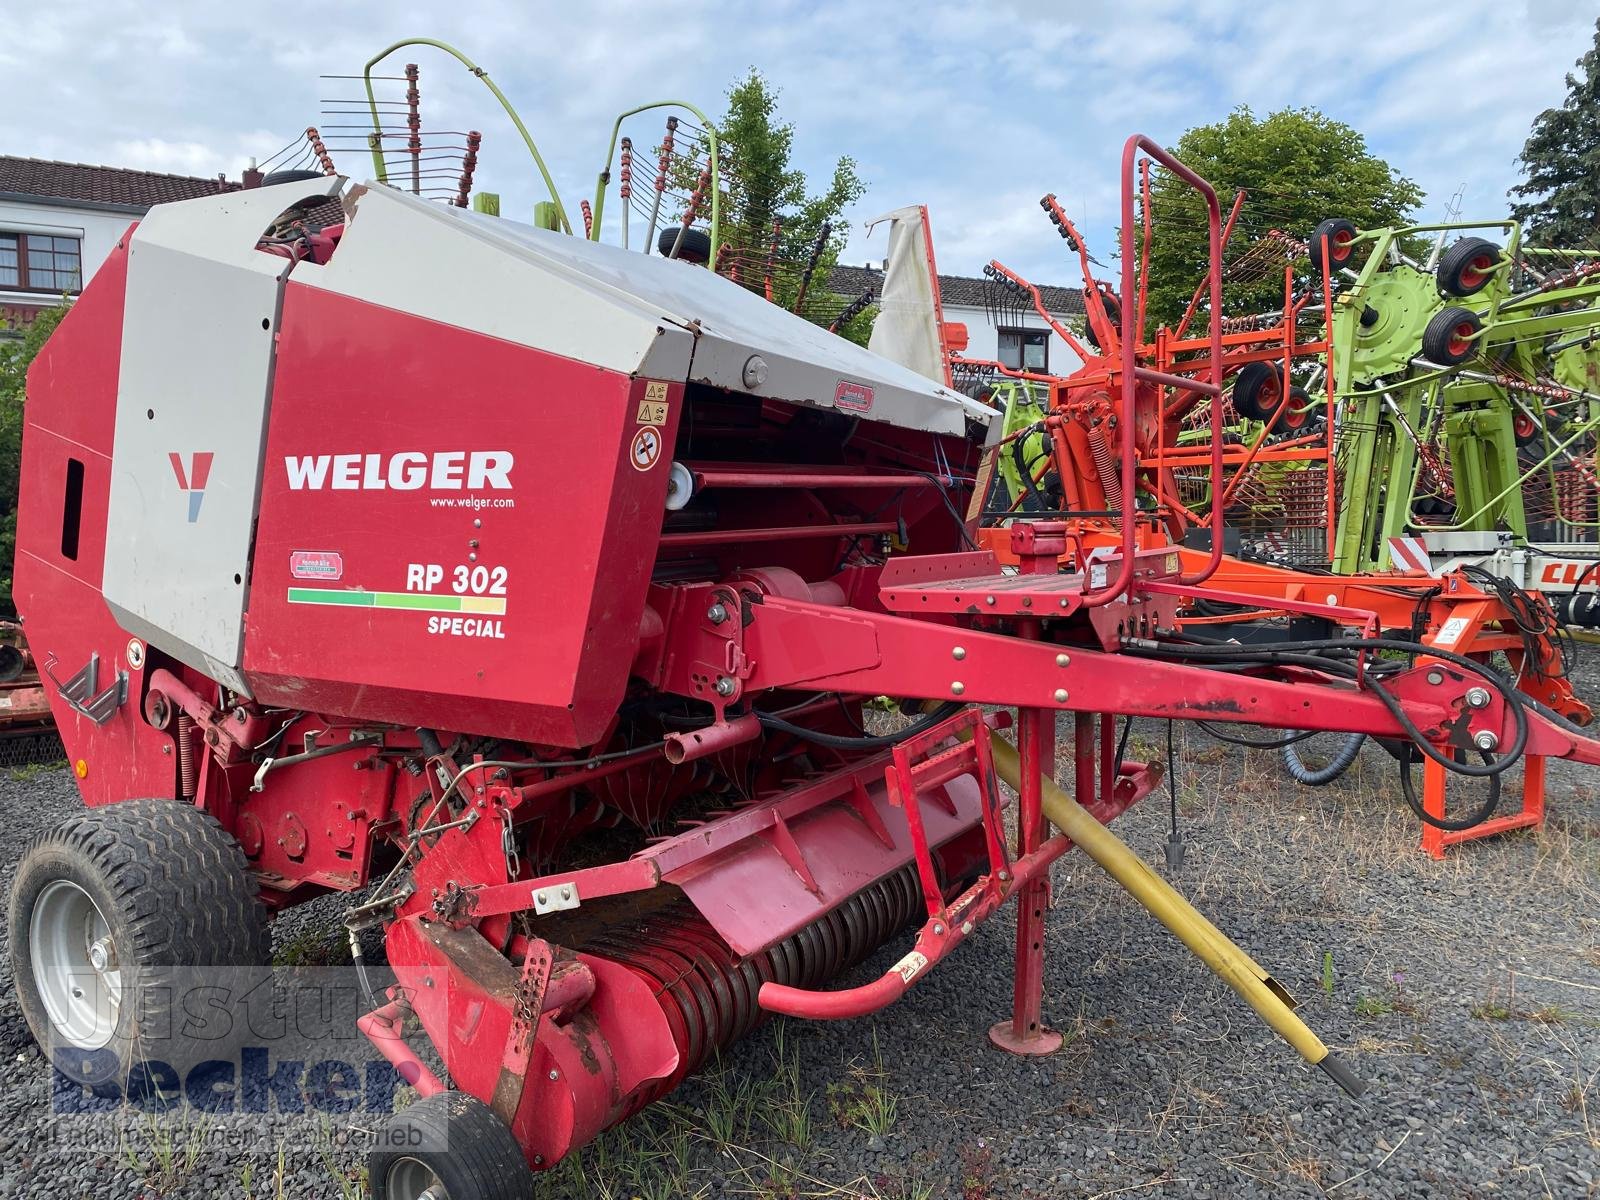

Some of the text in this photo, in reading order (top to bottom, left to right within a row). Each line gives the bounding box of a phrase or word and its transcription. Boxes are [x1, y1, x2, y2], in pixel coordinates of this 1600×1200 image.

[284, 450, 514, 491] WELGER
[430, 495, 514, 511] www.welger.com
[406, 563, 508, 595] RP 302
[427, 616, 506, 639] SPECIAL
